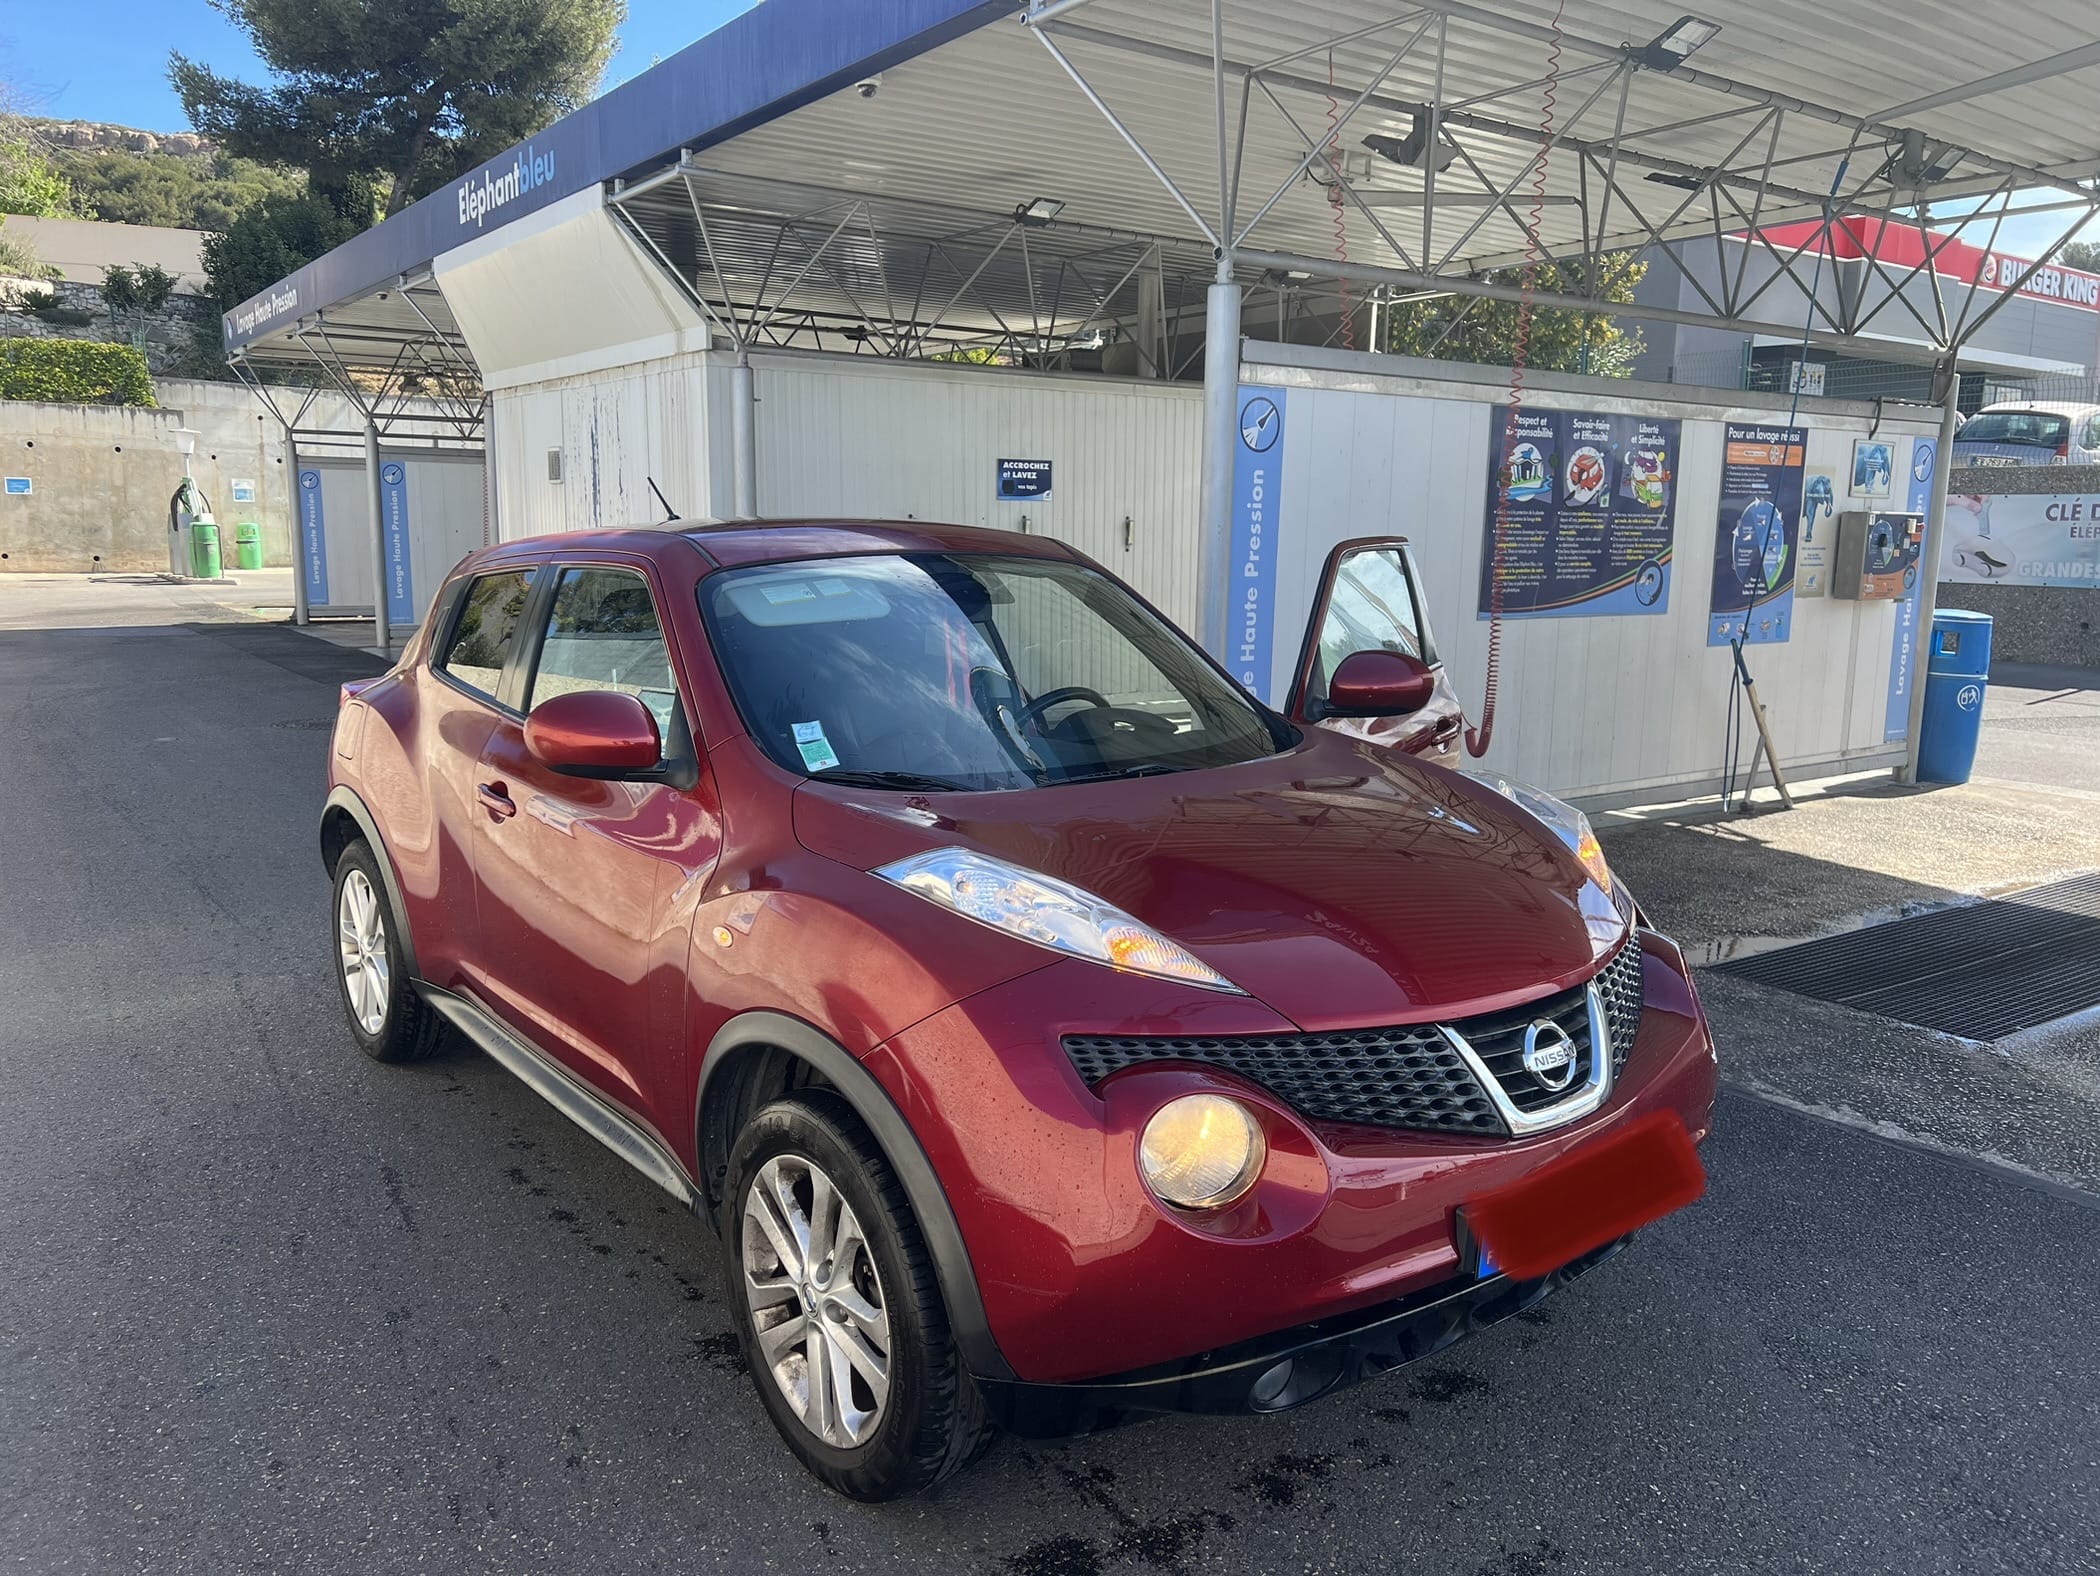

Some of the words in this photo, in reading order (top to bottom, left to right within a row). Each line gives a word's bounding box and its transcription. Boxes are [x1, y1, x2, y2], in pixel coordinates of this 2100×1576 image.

[2062, 273, 2098, 306] KING
[236, 312, 255, 335] Lavage
[254, 300, 272, 325] Haute
[272, 284, 298, 317] Pression
[1514, 414, 1540, 427] Respect
[1540, 417, 1547, 426] et
[1573, 418, 1610, 431] Savoir-faire
[1639, 423, 1659, 434] Liberté
[1573, 431, 1580, 440] et
[1581, 430, 1608, 442] Efficacité
[1631, 436, 1638, 444] et
[1638, 435, 1666, 447] Simplicité
[1728, 426, 1745, 439] Pour
[1746, 430, 1755, 440] un
[1756, 427, 1780, 444] lavage
[1003, 461, 1050, 470] ACCROCHEZ
[307, 493, 317, 527] Pression
[390, 490, 400, 531] Pression
[2045, 497, 2083, 522] CLÉ
[1244, 469, 1265, 577] Pression
[2070, 522, 2100, 539] ÉLÉP
[310, 529, 318, 554] Haute
[393, 533, 401, 562] Haute
[313, 555, 321, 584] Lavage
[395, 565, 404, 599] Lavage
[2018, 560, 2100, 580] GRANDES
[1240, 587, 1258, 662] Haute
[1896, 632, 1911, 695] Lavage
[1534, 1045, 1576, 1067] NISSAN
